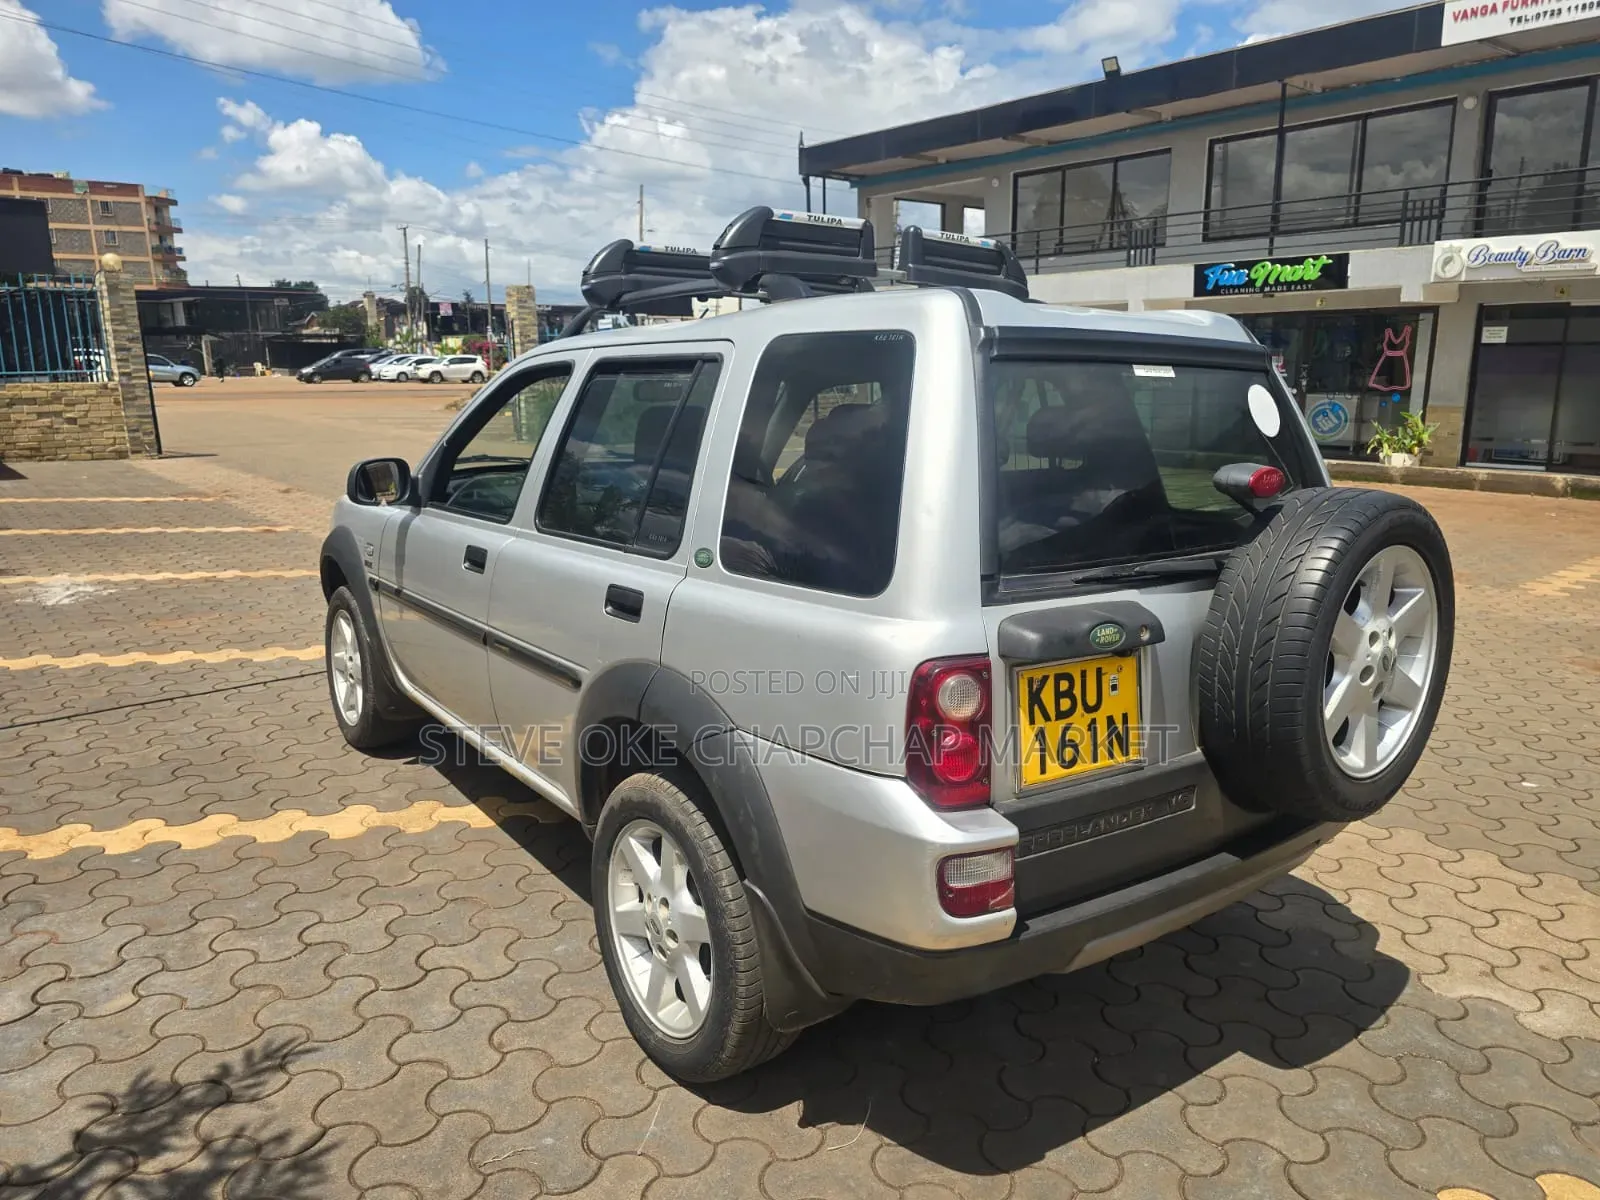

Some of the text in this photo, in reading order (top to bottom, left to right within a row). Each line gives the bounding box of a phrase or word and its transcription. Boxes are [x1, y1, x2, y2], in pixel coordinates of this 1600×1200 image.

[1452, 3, 1498, 23] VANGA
[806, 213, 843, 226] TULIPA
[939, 231, 970, 244] TULIPA
[664, 245, 698, 256] TULIPA
[1467, 239, 1588, 268] Beauty Barn
[1250, 255, 1333, 287] Mart
[1220, 286, 1261, 295] CLEANING
[1097, 627, 1114, 637] LAND
[1100, 633, 1121, 644] ROVER
[1028, 667, 1104, 726] KBU
[1034, 712, 1130, 775] 161N
